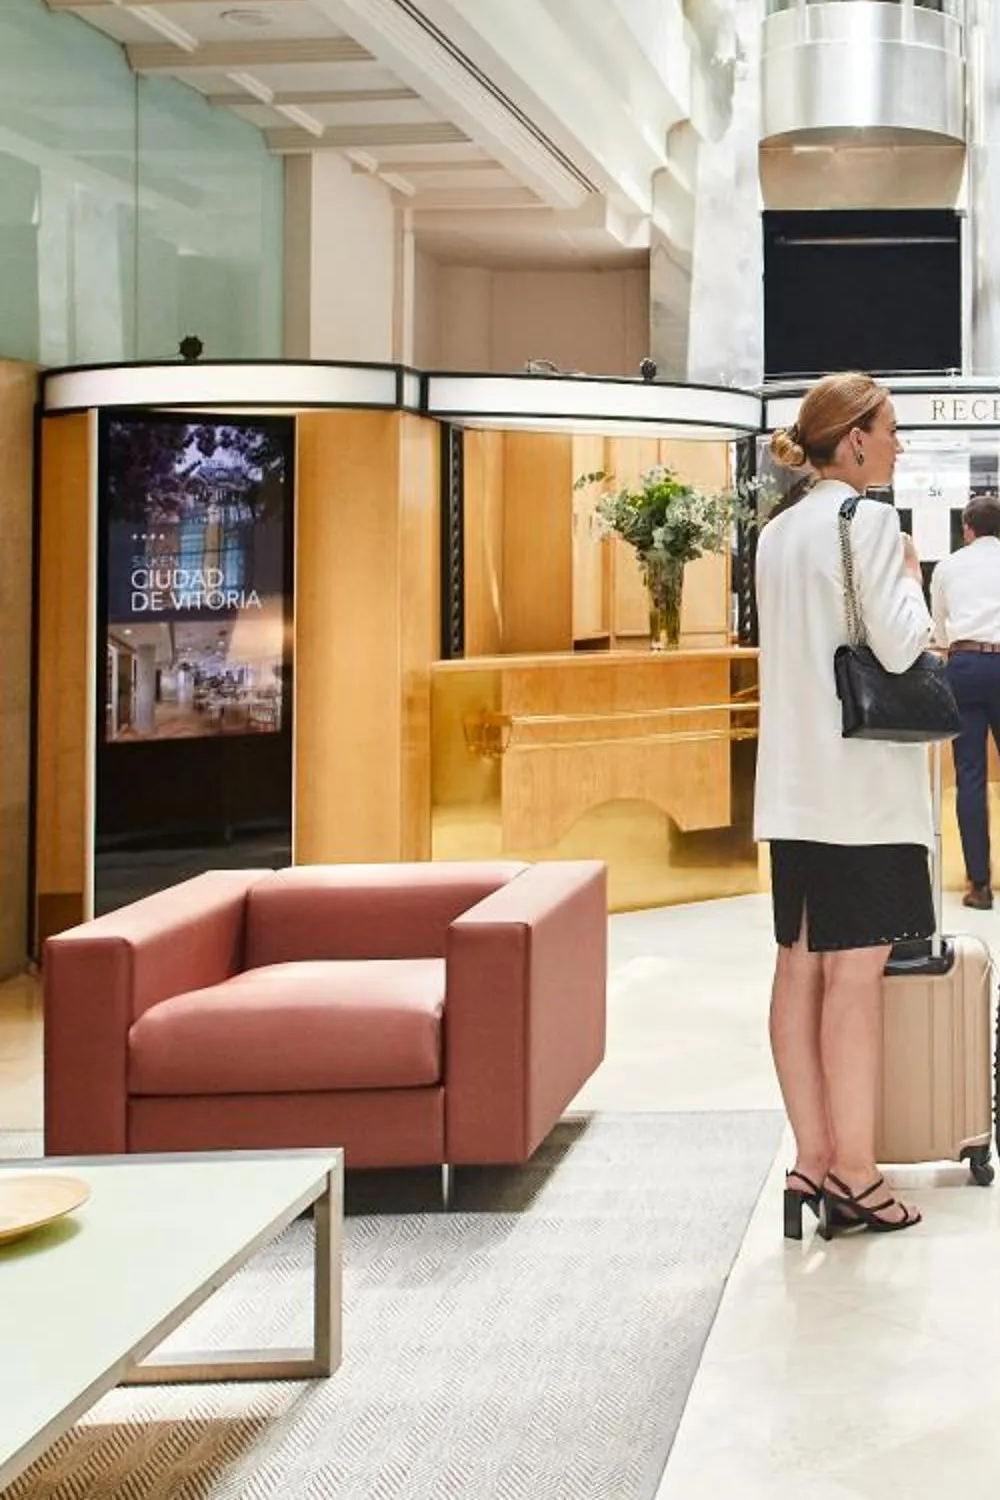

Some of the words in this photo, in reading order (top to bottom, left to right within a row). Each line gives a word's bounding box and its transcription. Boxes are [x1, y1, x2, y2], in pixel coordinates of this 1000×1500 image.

[131, 568, 224, 590] CIUDAD
[131, 591, 164, 612] DE
[170, 589, 262, 611] VITORIA
